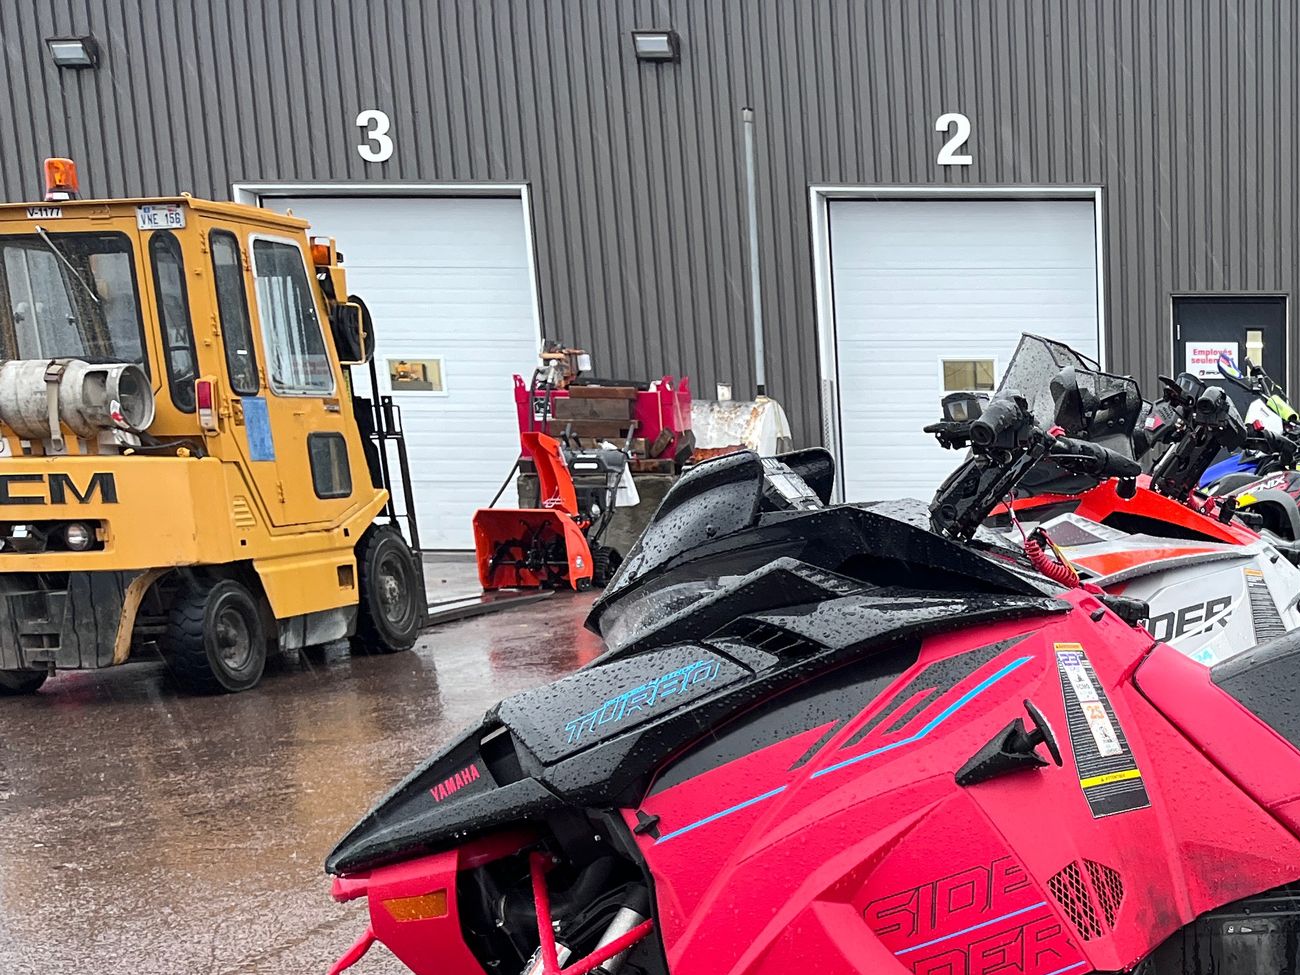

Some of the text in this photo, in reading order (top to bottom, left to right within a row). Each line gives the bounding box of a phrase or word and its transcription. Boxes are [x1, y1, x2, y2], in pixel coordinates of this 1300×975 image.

[355, 109, 394, 162] 3
[935, 112, 973, 165] 2
[27, 207, 60, 218] V-1177
[141, 213, 159, 225] VNE
[565, 659, 721, 744] TURBO
[430, 763, 480, 802] YAMAHA
